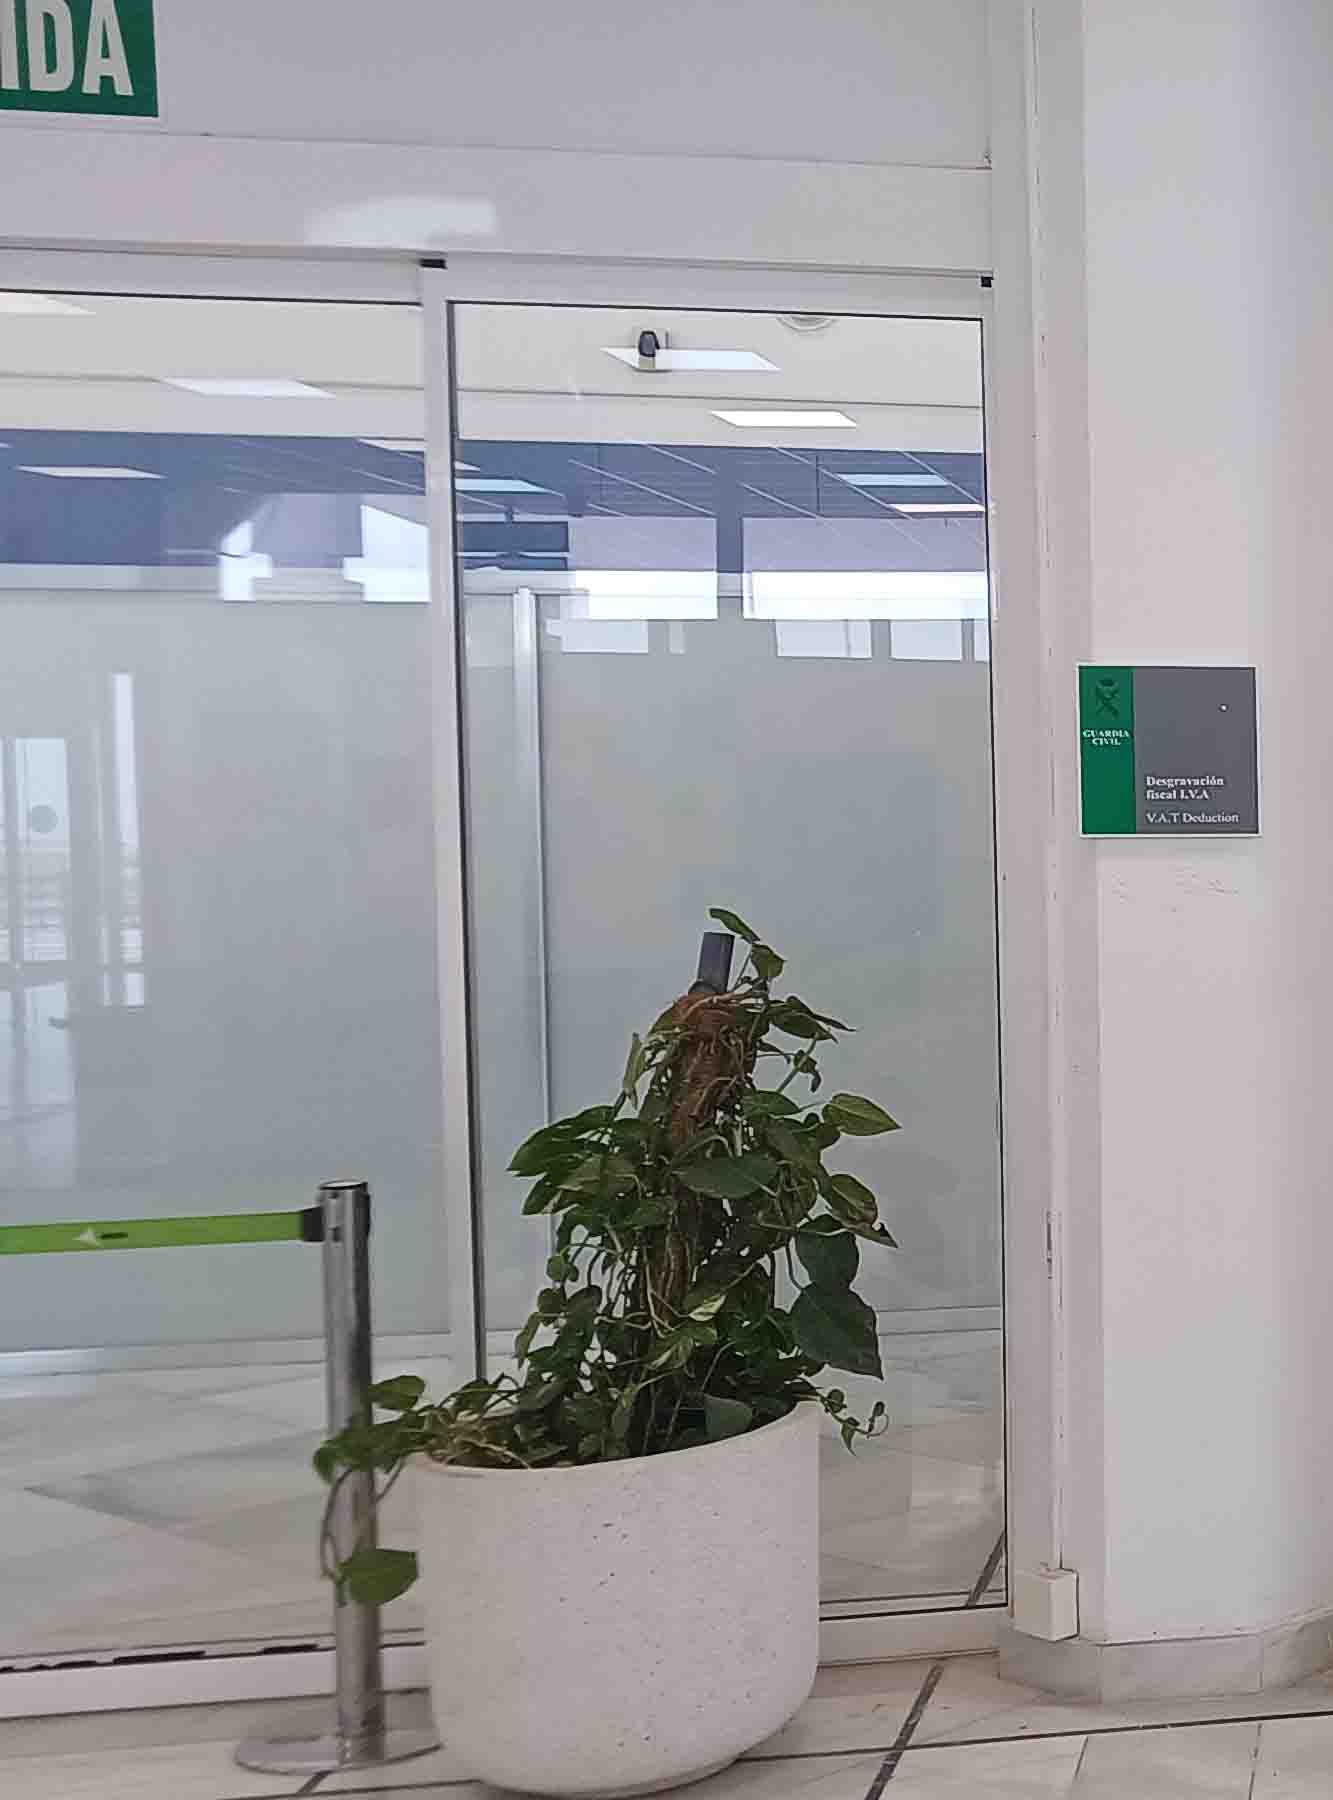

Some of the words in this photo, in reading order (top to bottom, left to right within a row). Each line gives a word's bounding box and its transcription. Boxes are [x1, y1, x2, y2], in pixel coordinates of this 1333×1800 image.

[0, 0, 134, 95] IDA
[1083, 729, 1130, 739] GUARDIA
[1092, 738, 1121, 746] CIVIL
[1146, 775, 1225, 788] Desgravación
[1146, 789, 1177, 800] fiscal
[1146, 812, 1180, 823] V.A.T
[1182, 812, 1240, 823] Deduction
